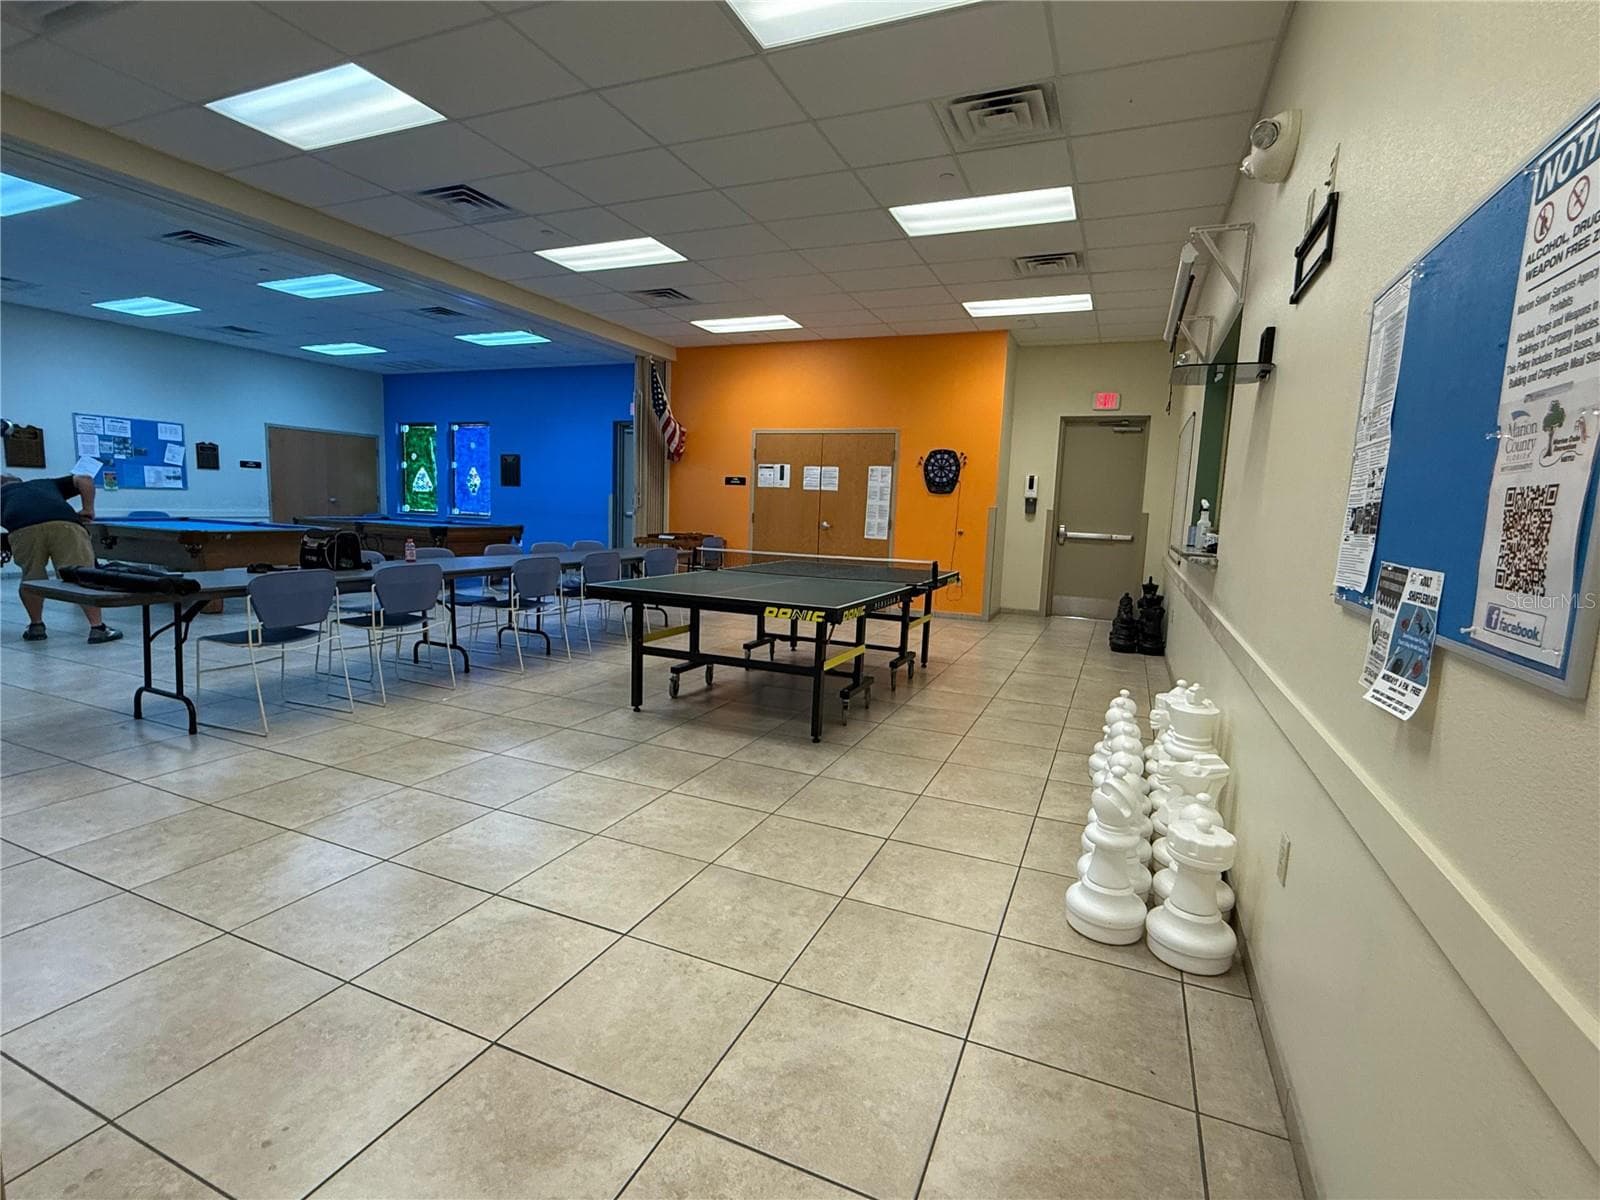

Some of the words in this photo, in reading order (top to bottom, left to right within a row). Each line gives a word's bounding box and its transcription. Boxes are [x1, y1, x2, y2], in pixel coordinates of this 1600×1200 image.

[1525, 251, 1563, 282] WEAPON
[1565, 233, 1591, 259] FREE
[1577, 267, 1599, 286] Agency
[1553, 314, 1563, 328] and
[1565, 304, 1591, 323] Weapons
[1547, 328, 1573, 346] Company
[1554, 342, 1573, 358] Transit
[1528, 370, 1537, 383] and
[1538, 361, 1570, 380] Congregate
[1570, 354, 1585, 369] Meal
[1508, 421, 1538, 438] Marion
[1505, 437, 1537, 457] County
[764, 606, 826, 623] DONIC
[1499, 617, 1540, 641] facebook
[1410, 686, 1423, 697] FREE
